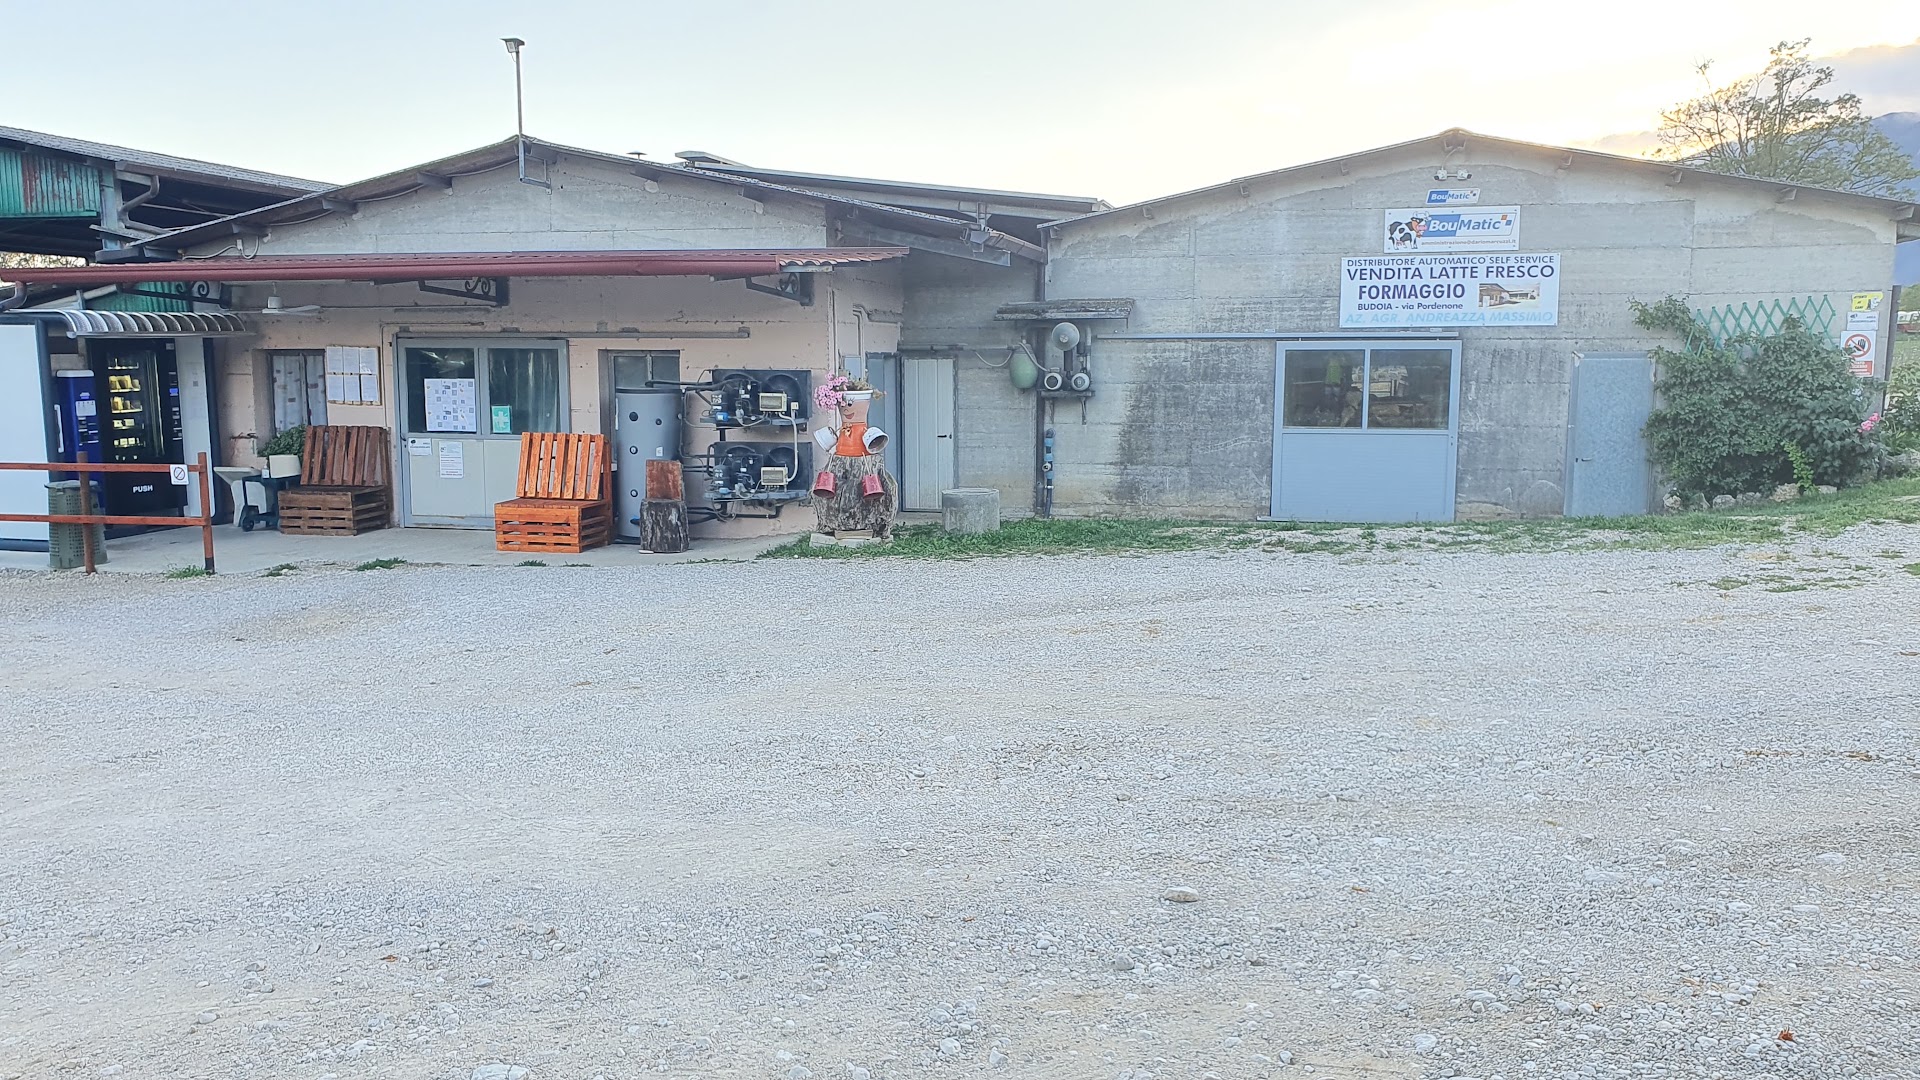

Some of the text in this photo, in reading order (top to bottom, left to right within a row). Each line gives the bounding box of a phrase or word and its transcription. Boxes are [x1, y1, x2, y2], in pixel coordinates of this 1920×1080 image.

[1431, 192, 1470, 200] BouMatic
[1429, 218, 1501, 232] BouMatic
[1347, 255, 1555, 267] DISTRIBUTORE AUTOMATICO SELF SERVICE
[1347, 265, 1555, 281] VENDITA LATTE FRESCO
[1358, 283, 1466, 300] FORMAGGIO
[1357, 303, 1393, 311] BUDOIA
[1417, 302, 1463, 310] Pordenone
[1345, 311, 1553, 323] AZ. AGR. ANDREAZZA MASSIMO
[132, 485, 154, 493] PUSH
